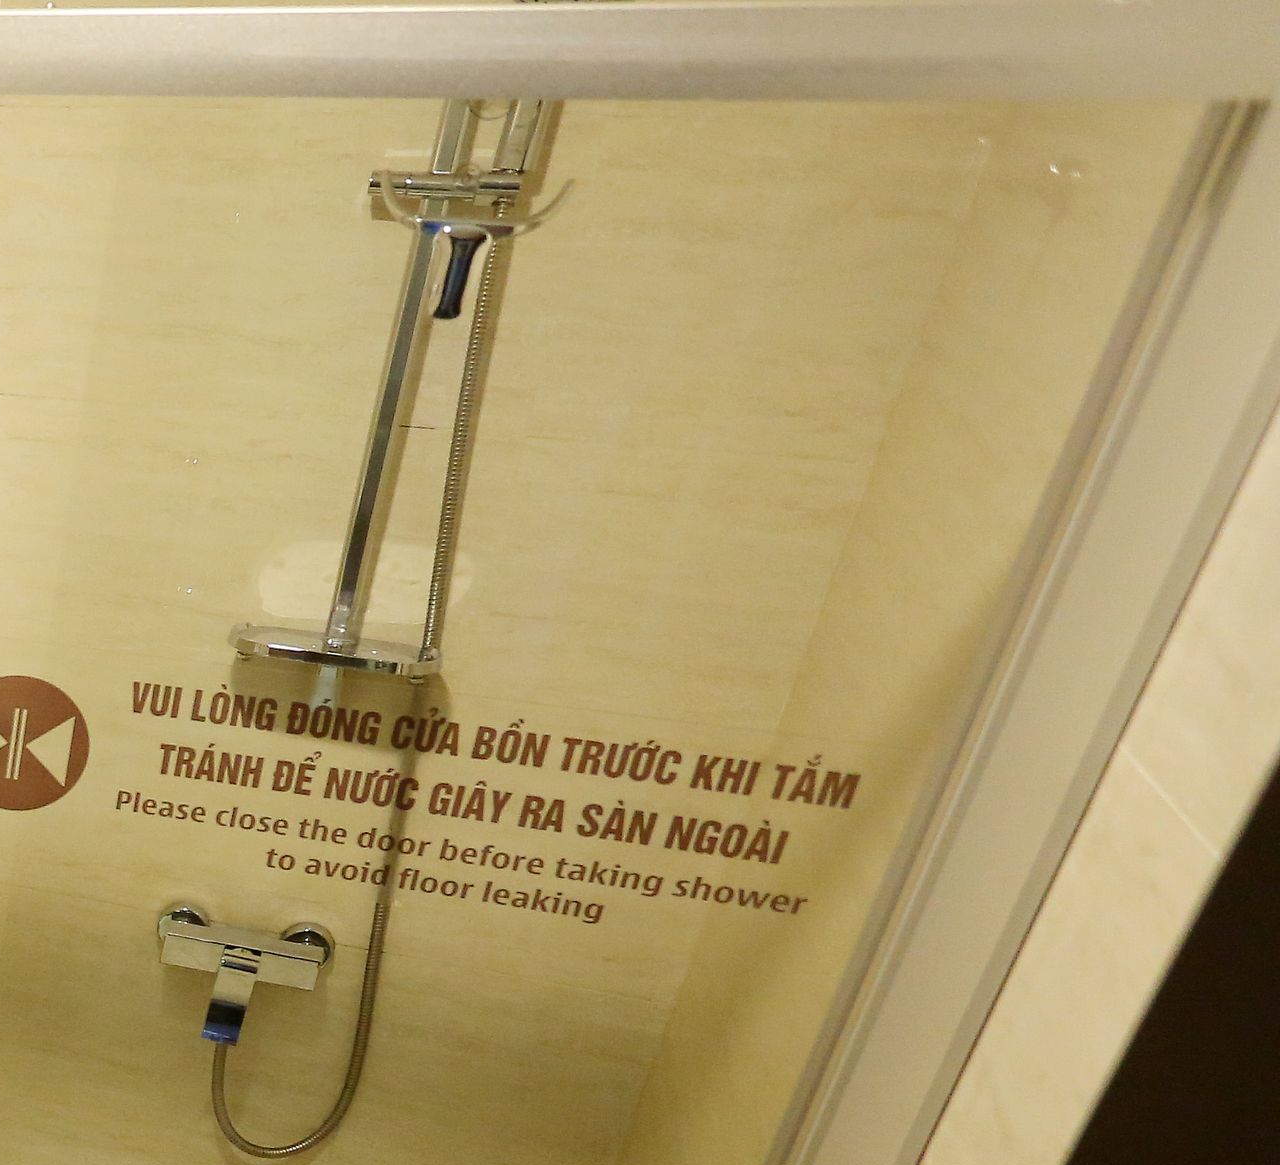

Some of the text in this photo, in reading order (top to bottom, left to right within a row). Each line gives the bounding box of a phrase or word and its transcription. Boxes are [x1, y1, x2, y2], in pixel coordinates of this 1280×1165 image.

[133, 681, 862, 809] VUI LÒNG ĐÓNG CỬA BỒN TRƯỚC KHI TẮM
[160, 743, 790, 864] TRÁNH ĐỂ NƯỚC GIÂY RA SÀN NGOÀI
[115, 790, 808, 916] Please close the door before taking shower
[266, 848, 605, 925] to avoid floor leaking
